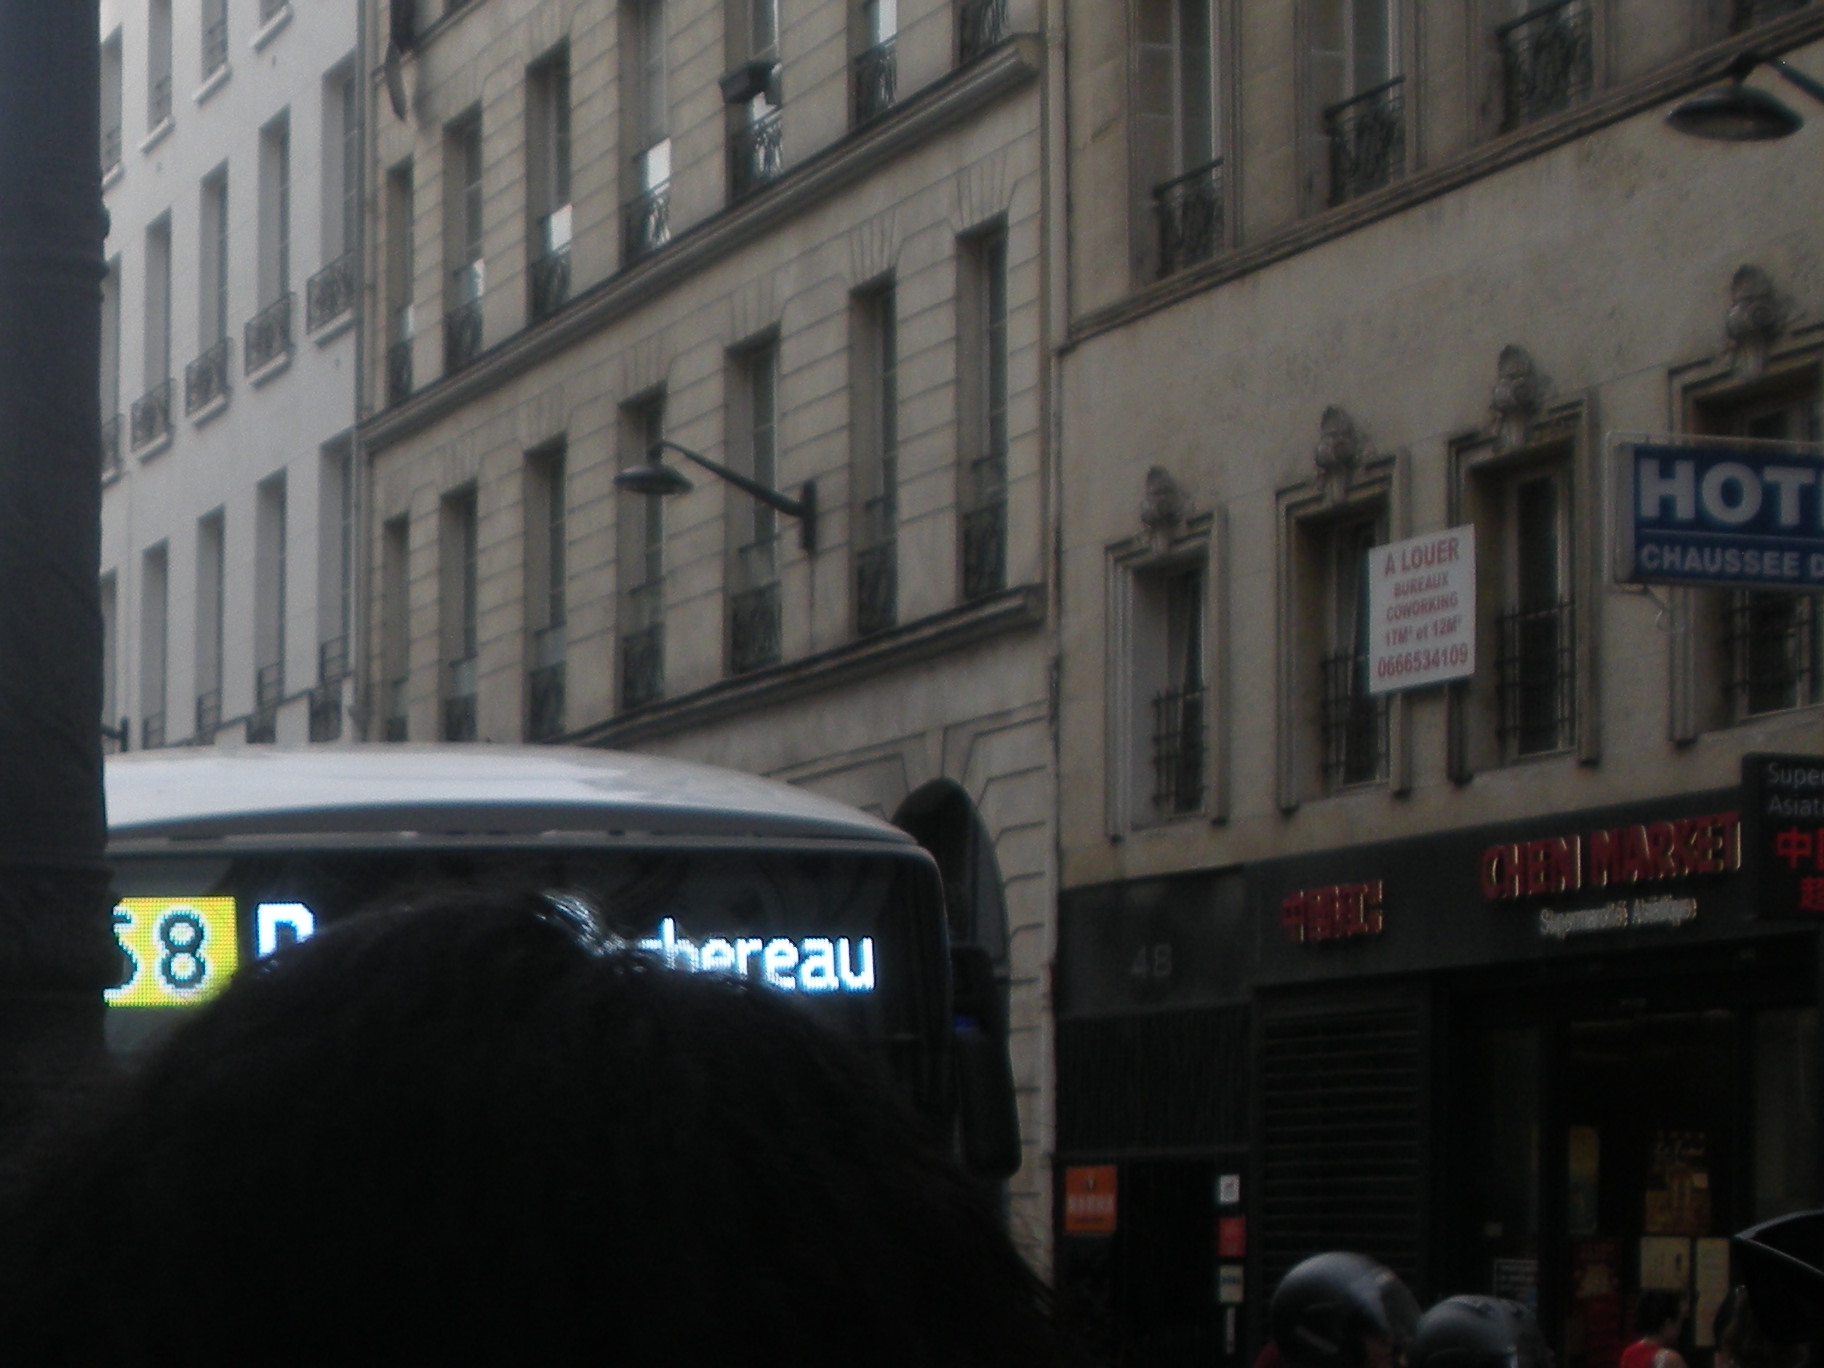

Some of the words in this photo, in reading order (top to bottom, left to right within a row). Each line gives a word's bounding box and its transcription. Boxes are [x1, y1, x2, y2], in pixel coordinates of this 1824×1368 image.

[1639, 457, 1824, 529] HOT
[1385, 551, 1396, 576] A
[1401, 536, 1460, 572] LOUER
[1640, 543, 1800, 578] CHAUSSEE
[1393, 571, 1449, 598] BUREAUX
[1386, 591, 1458, 622] COWORKING
[1767, 792, 1824, 816] Asiat
[1479, 833, 1582, 900] CHEN
[1589, 810, 1742, 888] MARKET
[639, 915, 877, 993] hereau
